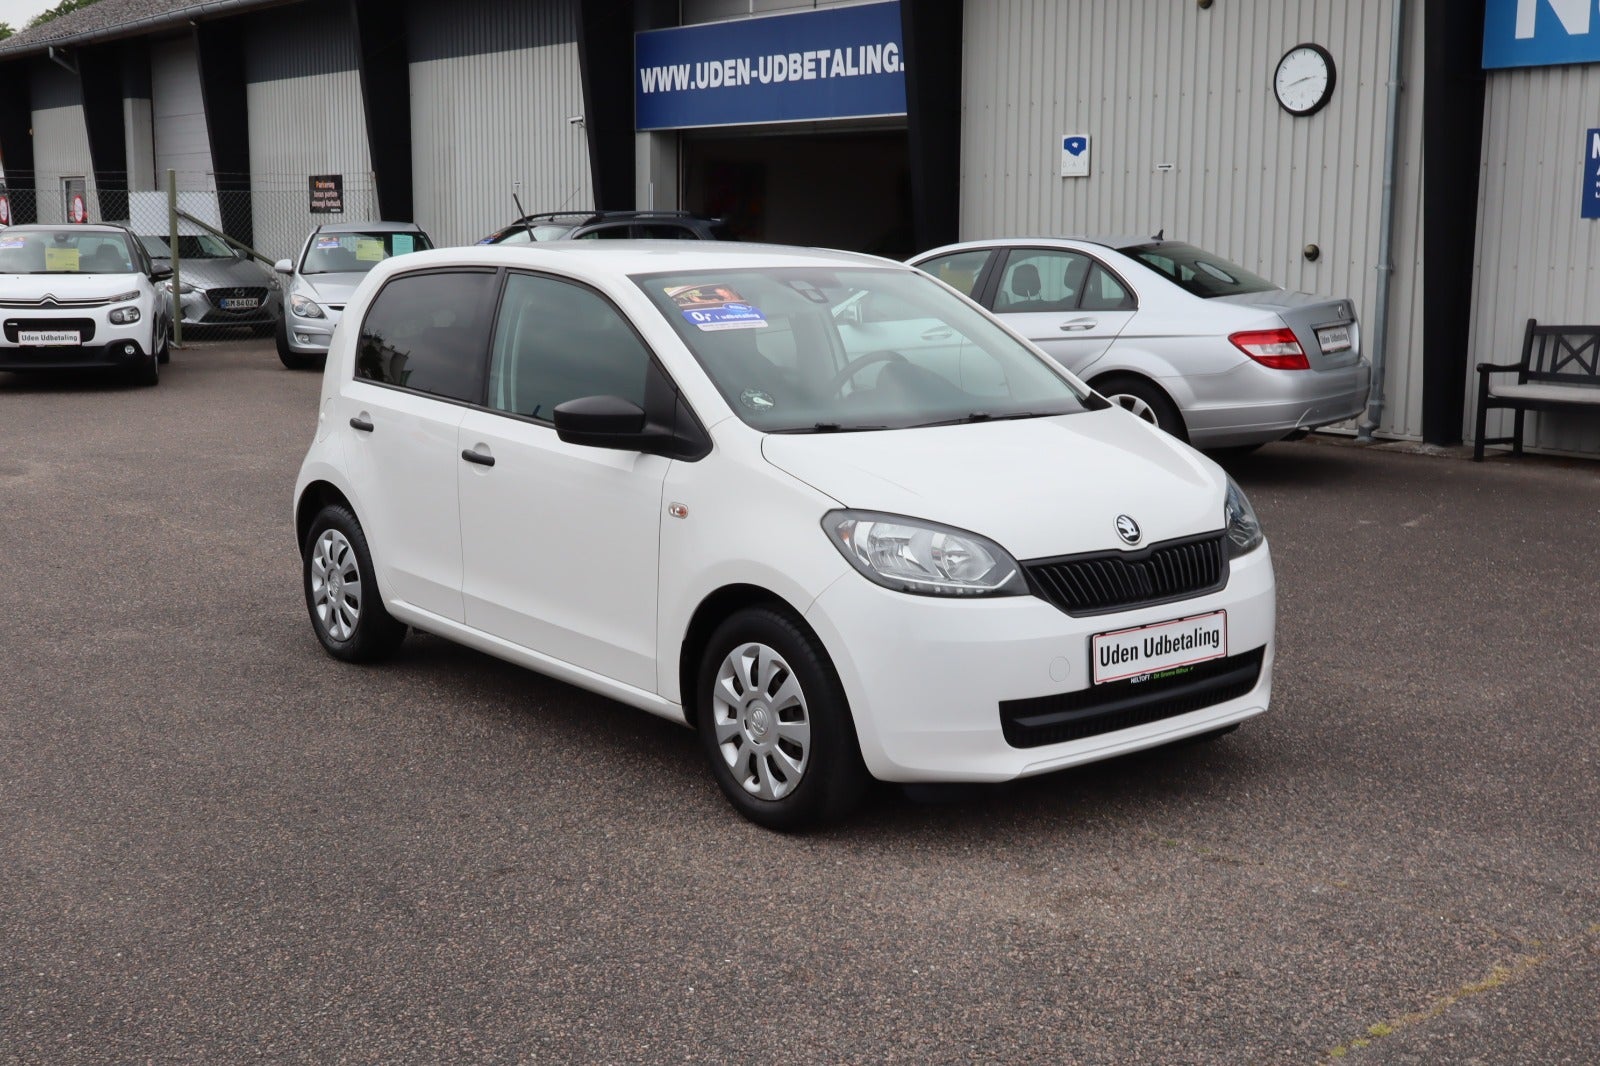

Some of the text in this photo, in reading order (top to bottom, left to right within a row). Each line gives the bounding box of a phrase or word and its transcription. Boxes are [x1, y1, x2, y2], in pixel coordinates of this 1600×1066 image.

[640, 42, 904, 93] WWW.UDEN-UDBETALING.
[41, 334, 78, 342] Udbetaling
[1100, 627, 1220, 667] Uden Udbetaling
